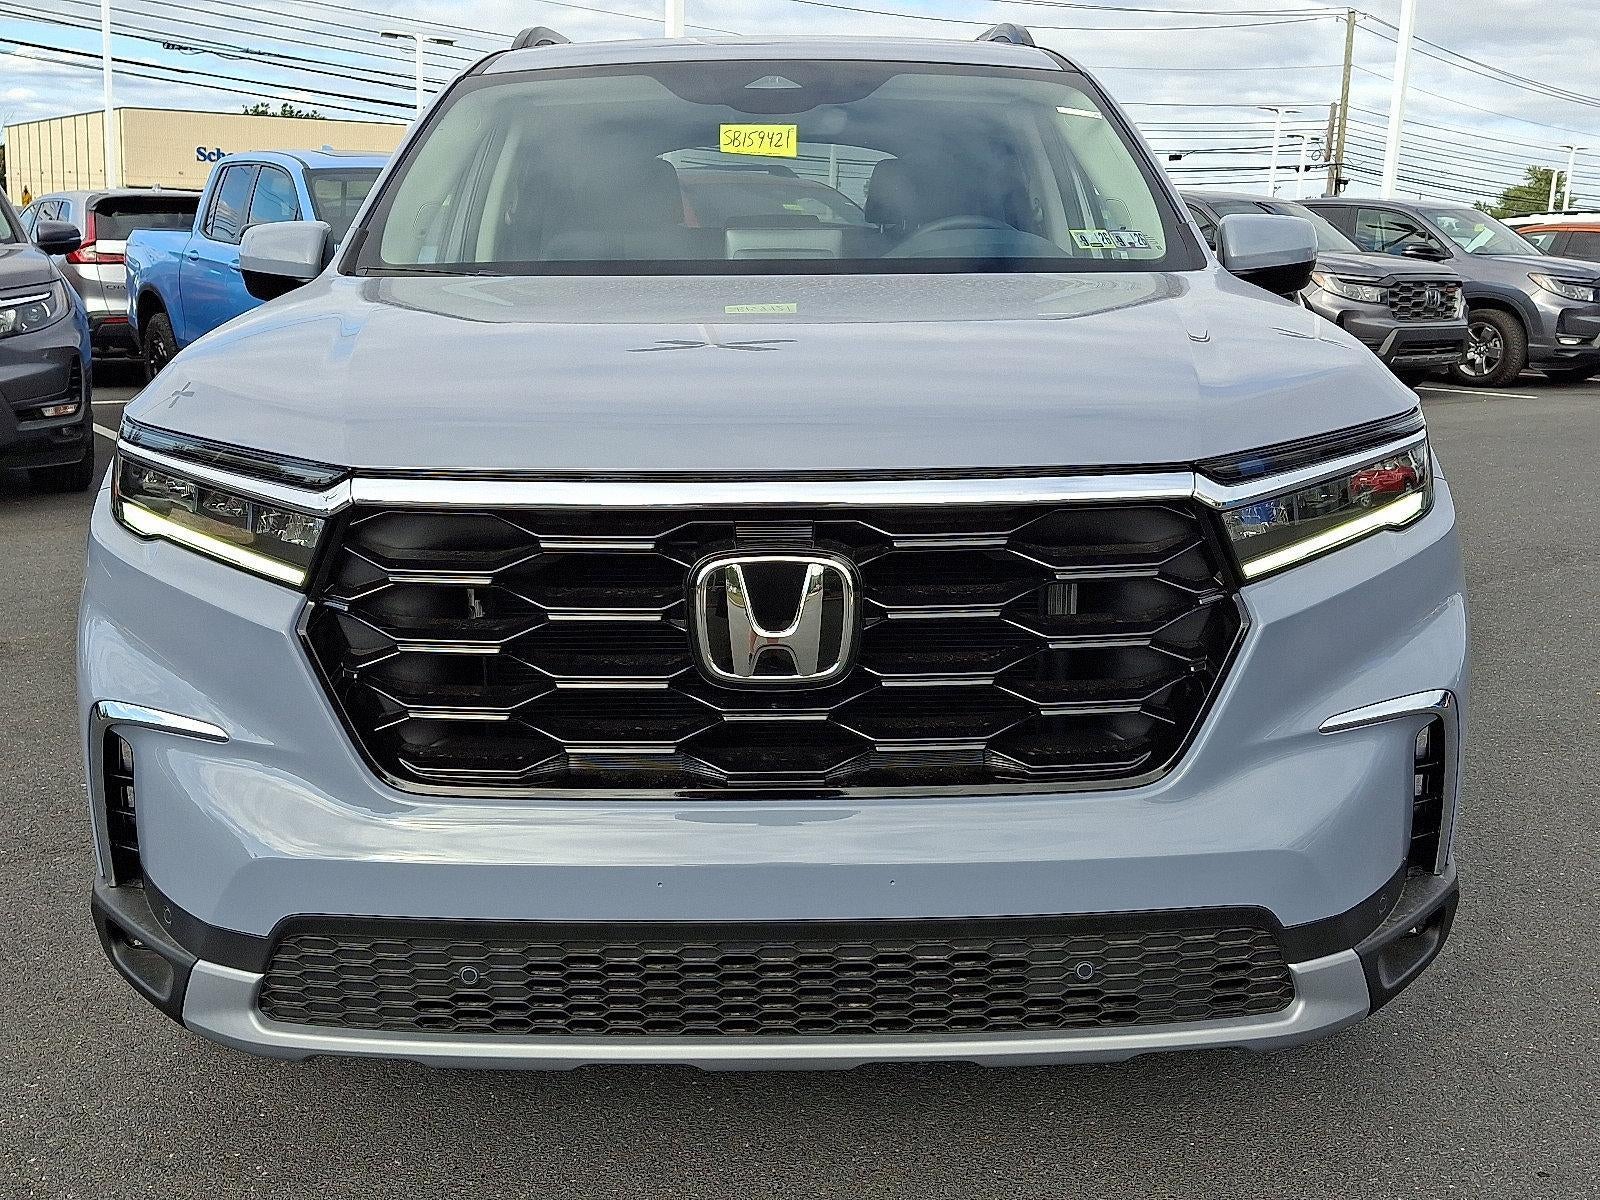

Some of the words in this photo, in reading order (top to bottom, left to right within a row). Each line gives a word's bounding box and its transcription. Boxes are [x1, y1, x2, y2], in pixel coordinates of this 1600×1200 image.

[196, 146, 234, 162] Sch
[1079, 234, 1090, 247] 9
[1115, 235, 1127, 247] 9
